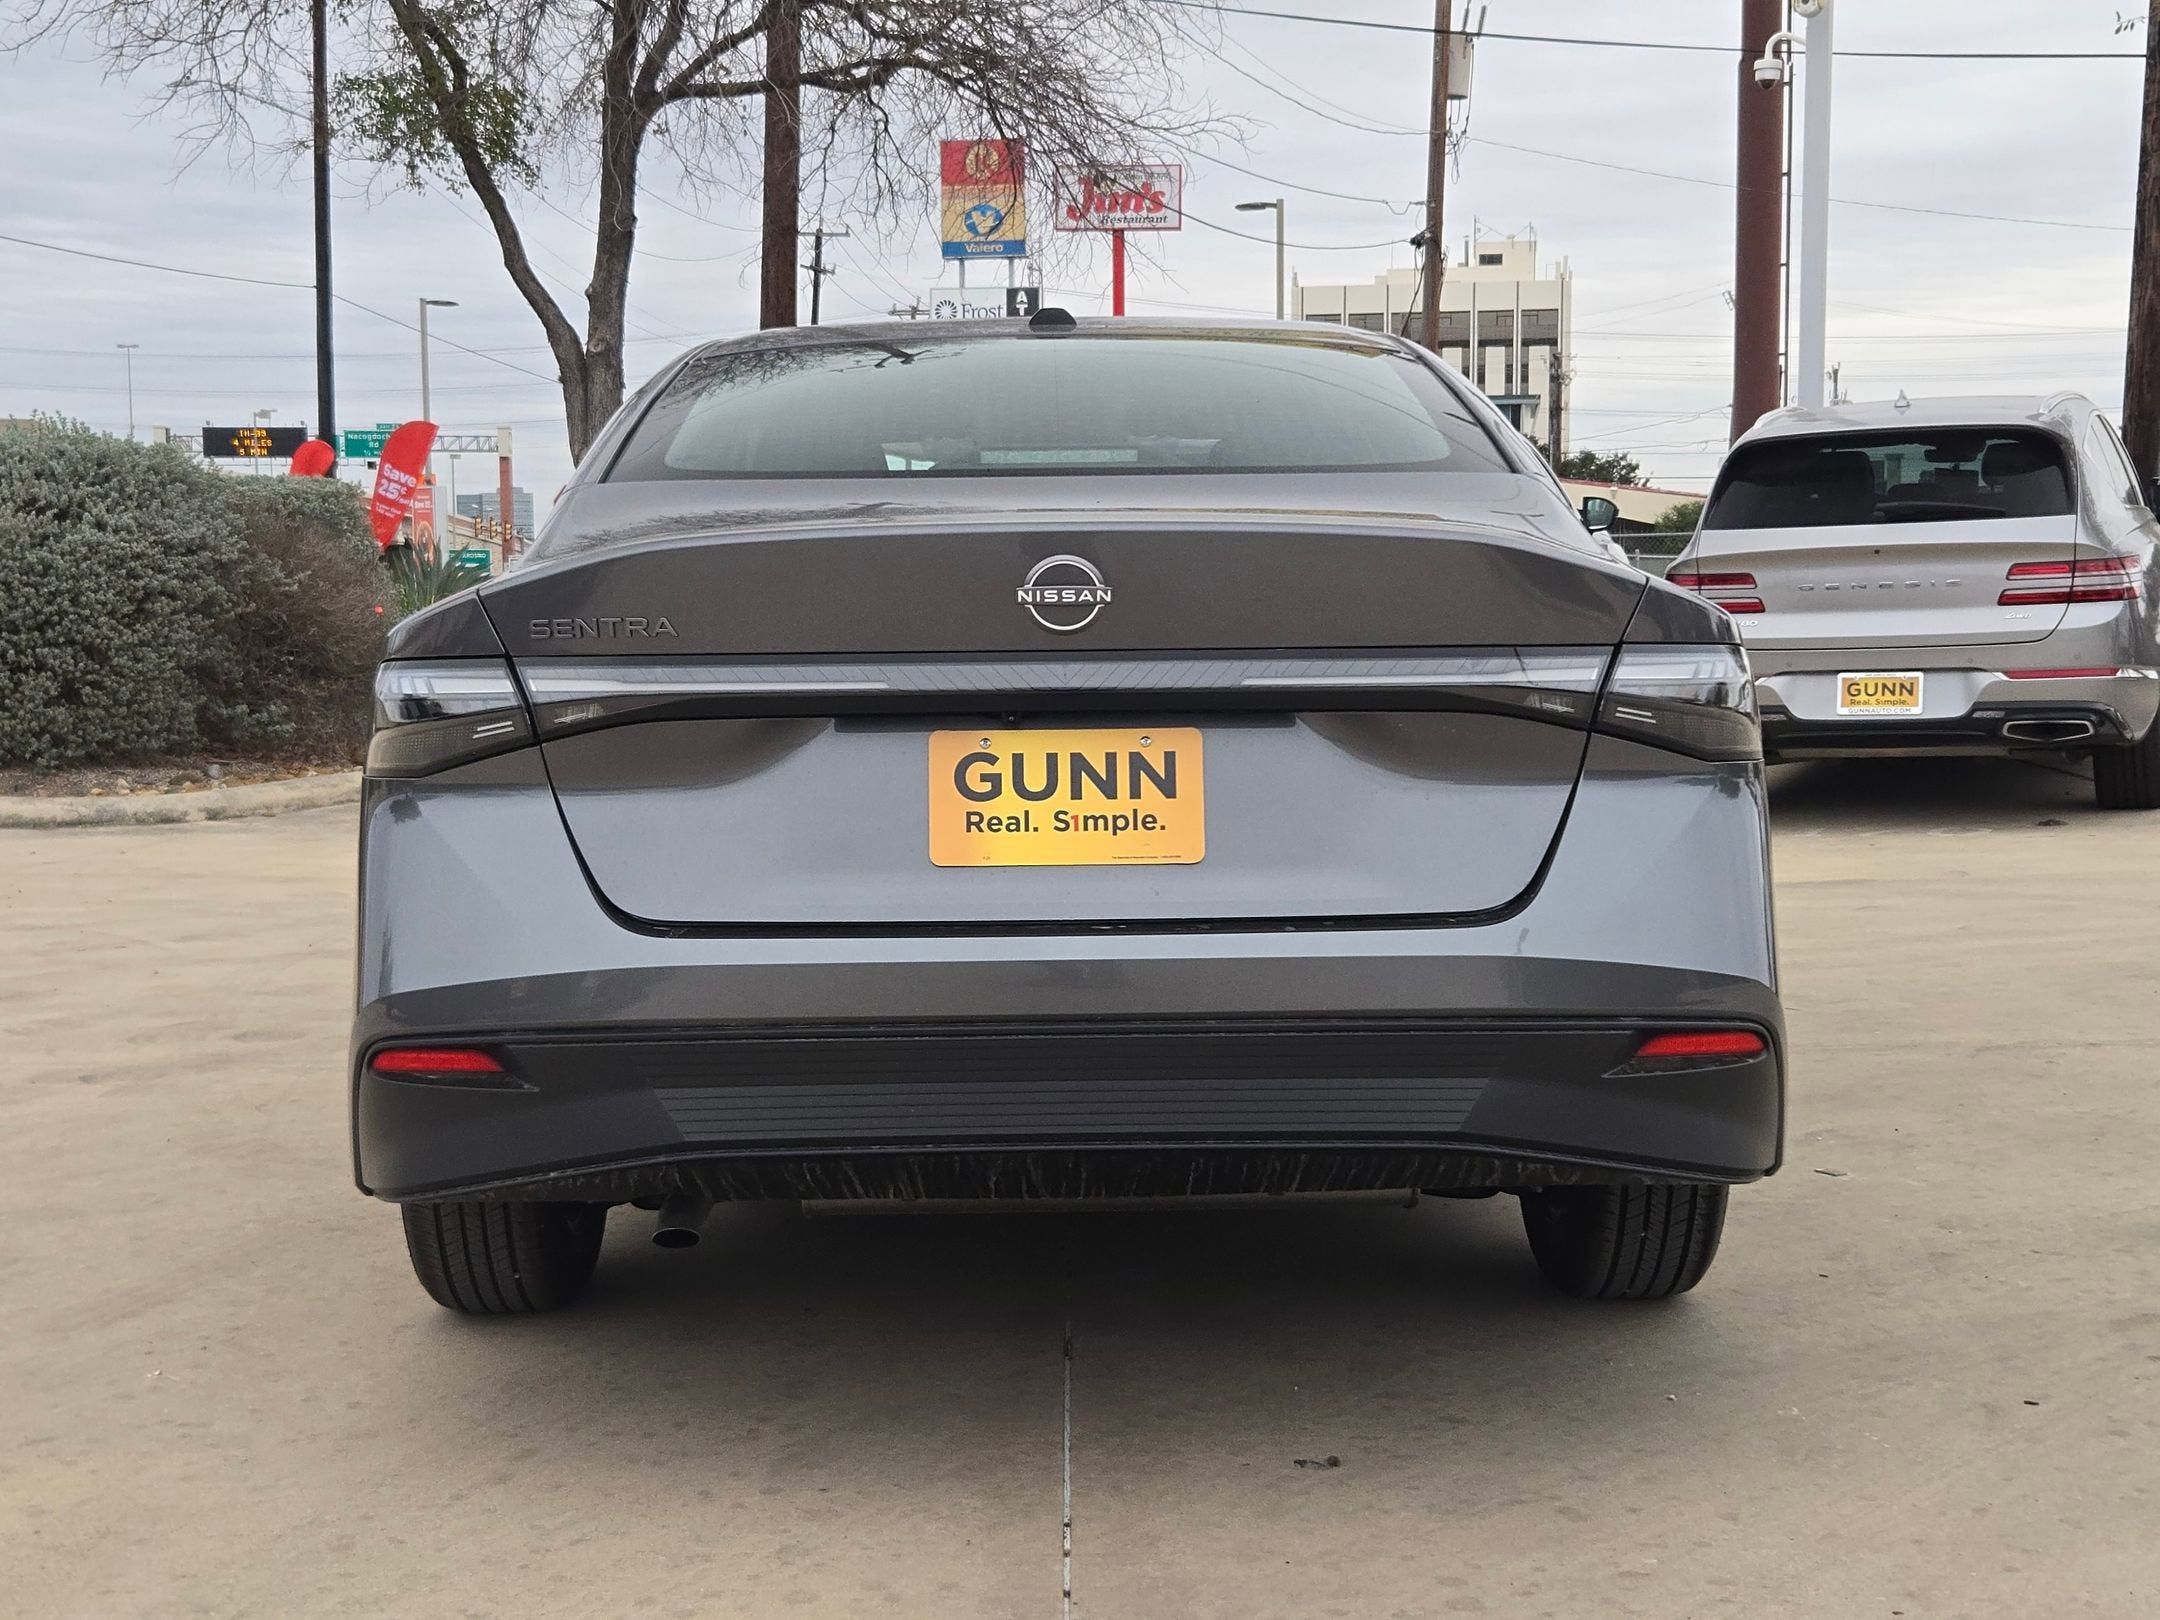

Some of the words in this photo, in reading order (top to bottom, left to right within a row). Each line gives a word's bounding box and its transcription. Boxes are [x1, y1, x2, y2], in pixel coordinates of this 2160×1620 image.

[1066, 175, 1166, 222] Jim's
[1101, 215, 1168, 224] Restaurant
[964, 243, 1004, 253] Valero
[1015, 290, 1029, 316] AT
[961, 304, 1003, 319] Frost
[347, 433, 391, 441] Nacogdoch
[383, 463, 417, 487] Save
[1798, 579, 1962, 591] GENESIS
[1018, 590, 1111, 602] NISSAN
[529, 617, 679, 640] SENTRA
[1847, 682, 1914, 697] GUNN
[1850, 698, 1873, 706] Real.
[953, 751, 1177, 802] GUNN
[965, 810, 1039, 833] Real.
